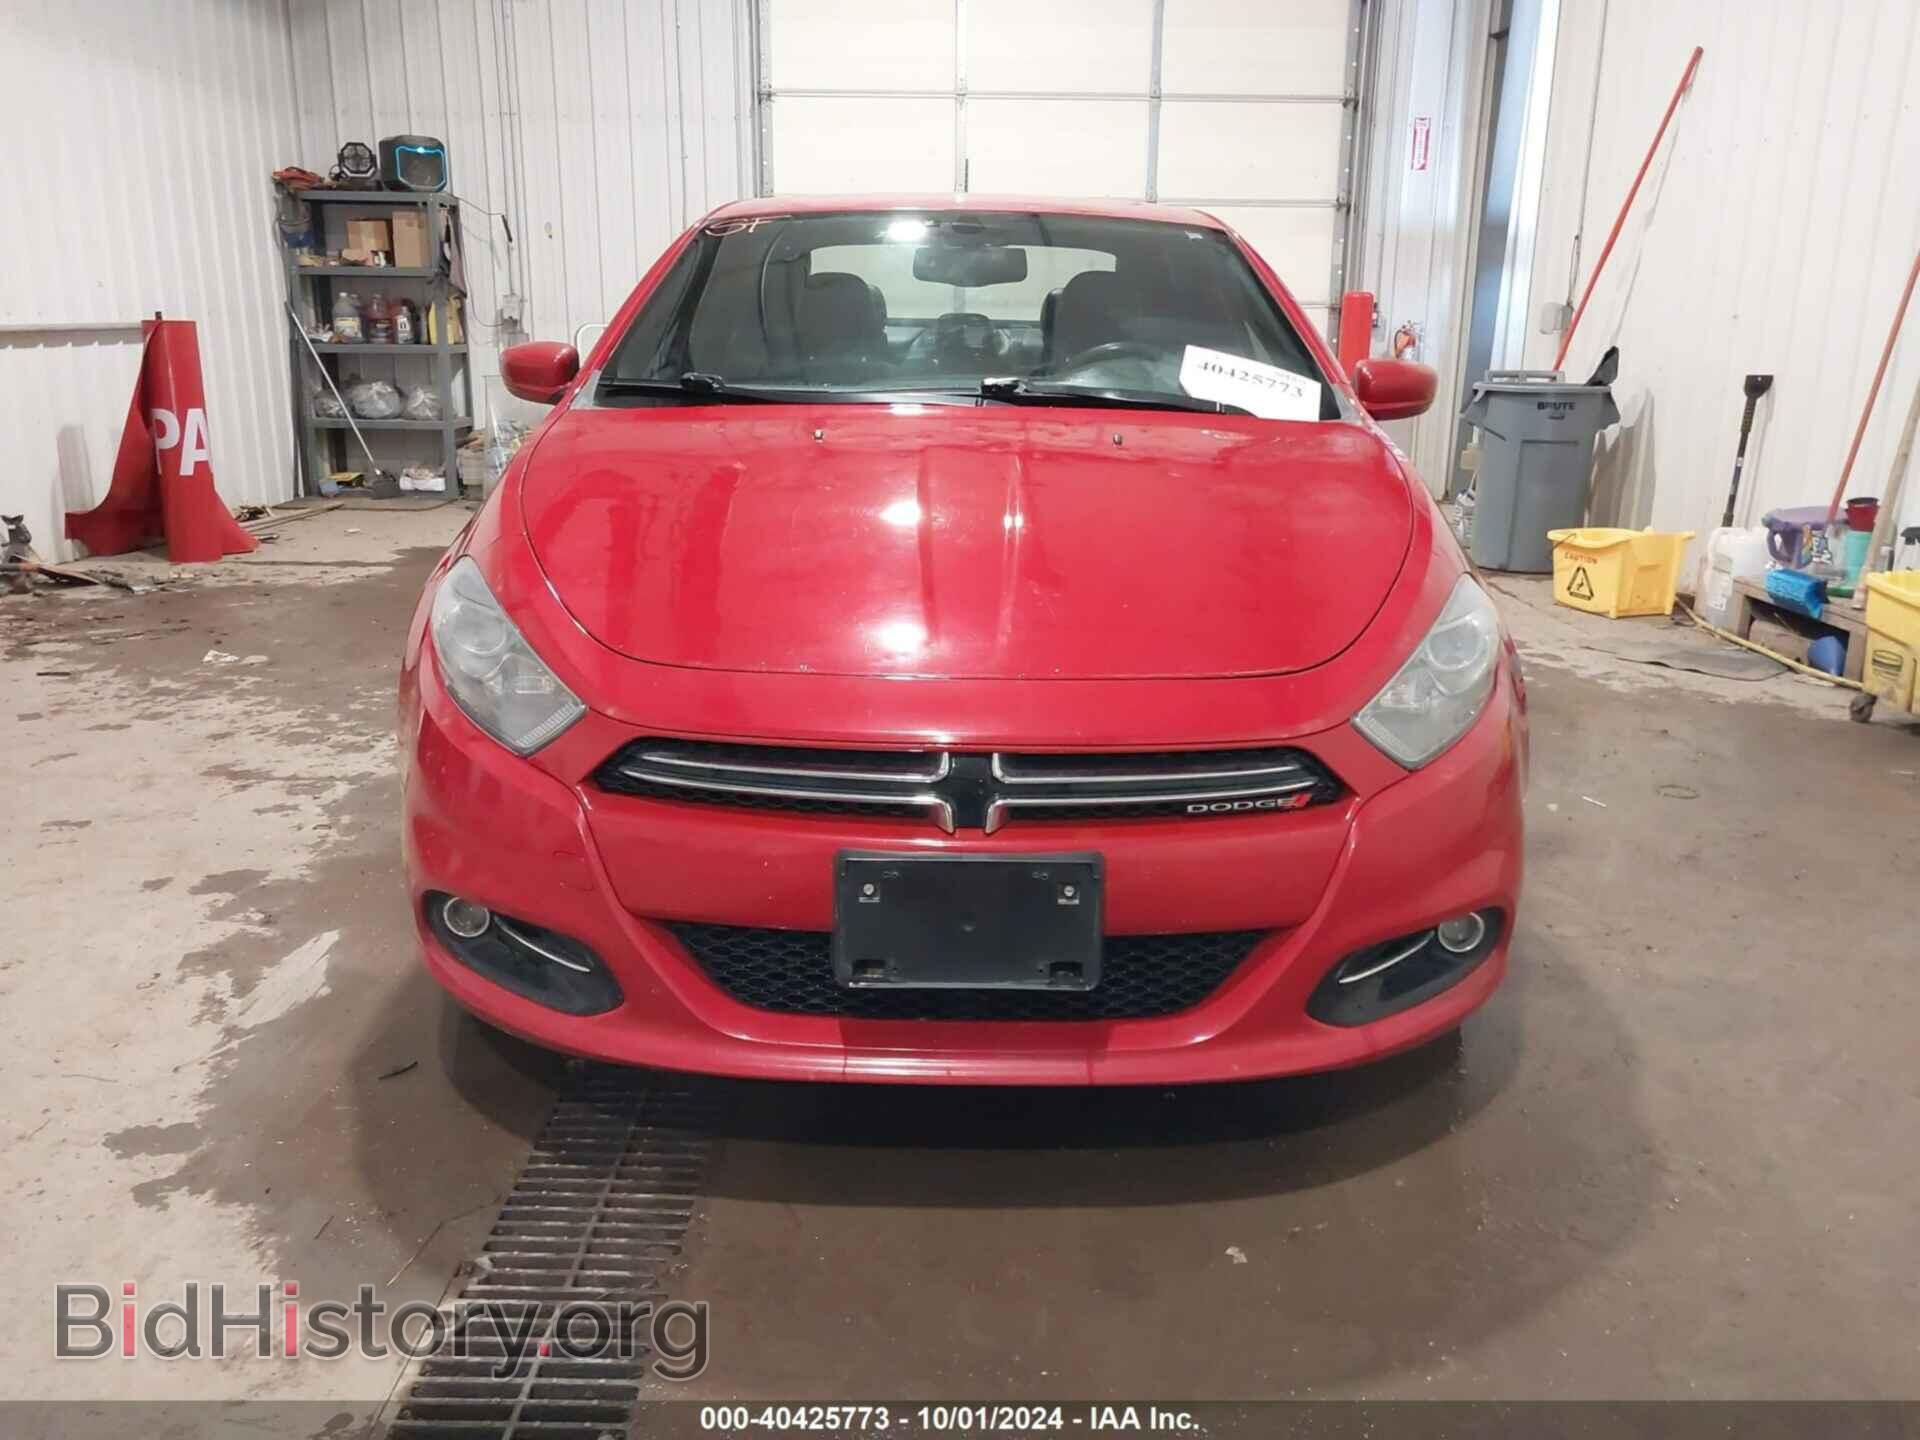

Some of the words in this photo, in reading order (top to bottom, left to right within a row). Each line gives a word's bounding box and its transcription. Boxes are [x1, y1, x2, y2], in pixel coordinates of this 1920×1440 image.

[1197, 361, 1304, 398] 40425773
[1537, 401, 1576, 411] BRUTE
[1564, 551, 1598, 565] CAUTION
[1187, 798, 1300, 814] DODGE
